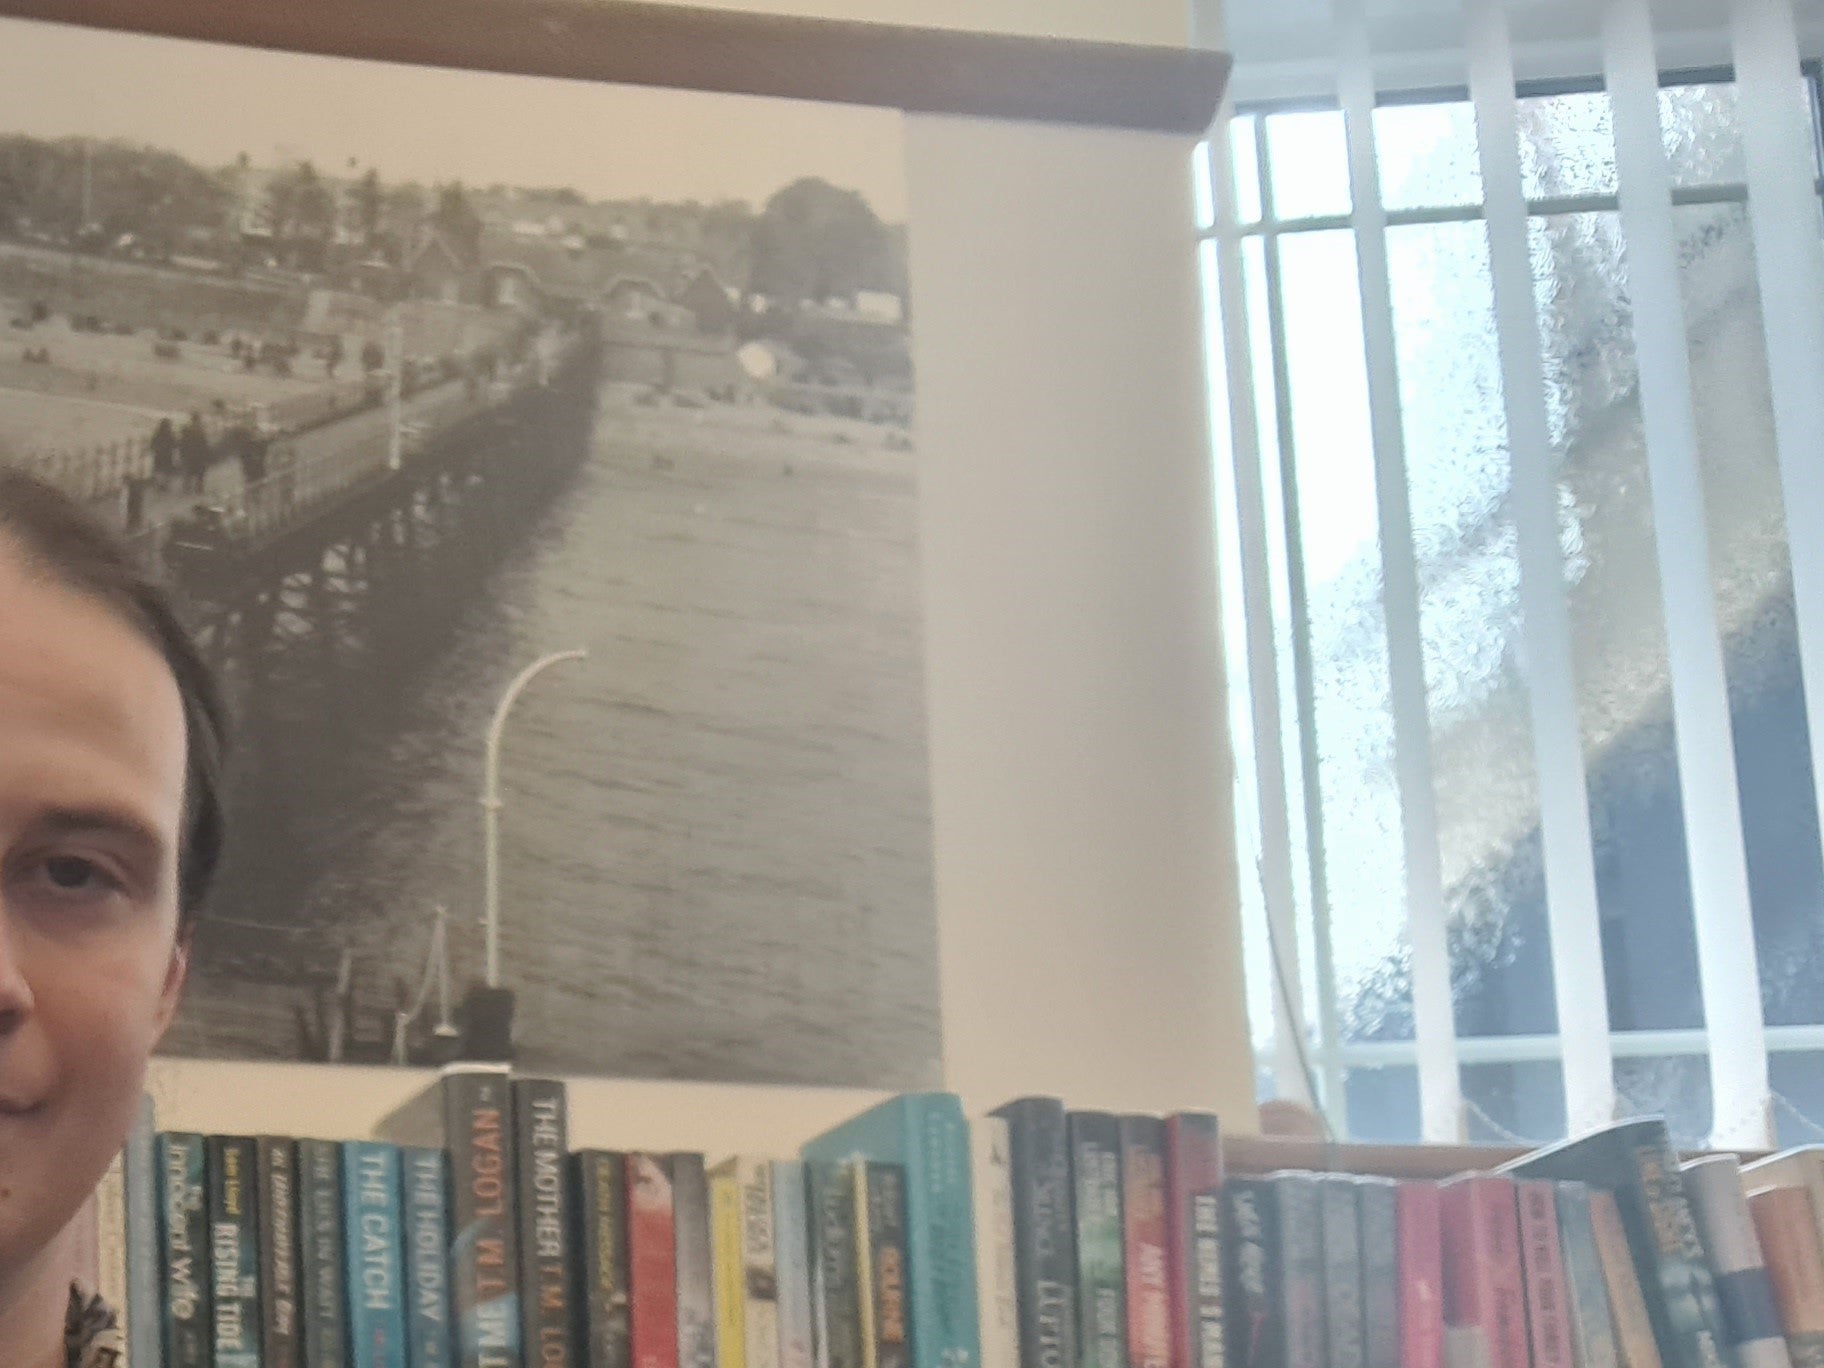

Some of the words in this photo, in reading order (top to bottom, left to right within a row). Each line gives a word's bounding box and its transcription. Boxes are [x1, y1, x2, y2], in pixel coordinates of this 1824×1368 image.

[532, 1100, 559, 1147] THE
[359, 1153, 389, 1208] THE
[414, 1154, 442, 1209] THE
[471, 1107, 504, 1217] LOGAN
[535, 1150, 563, 1258] MOTHER
[214, 1222, 239, 1297] RISING
[362, 1212, 392, 1311] CATCH
[417, 1211, 444, 1323] HOLIDAY
[217, 1303, 242, 1350] TIDE
[477, 1303, 509, 1349] ME
